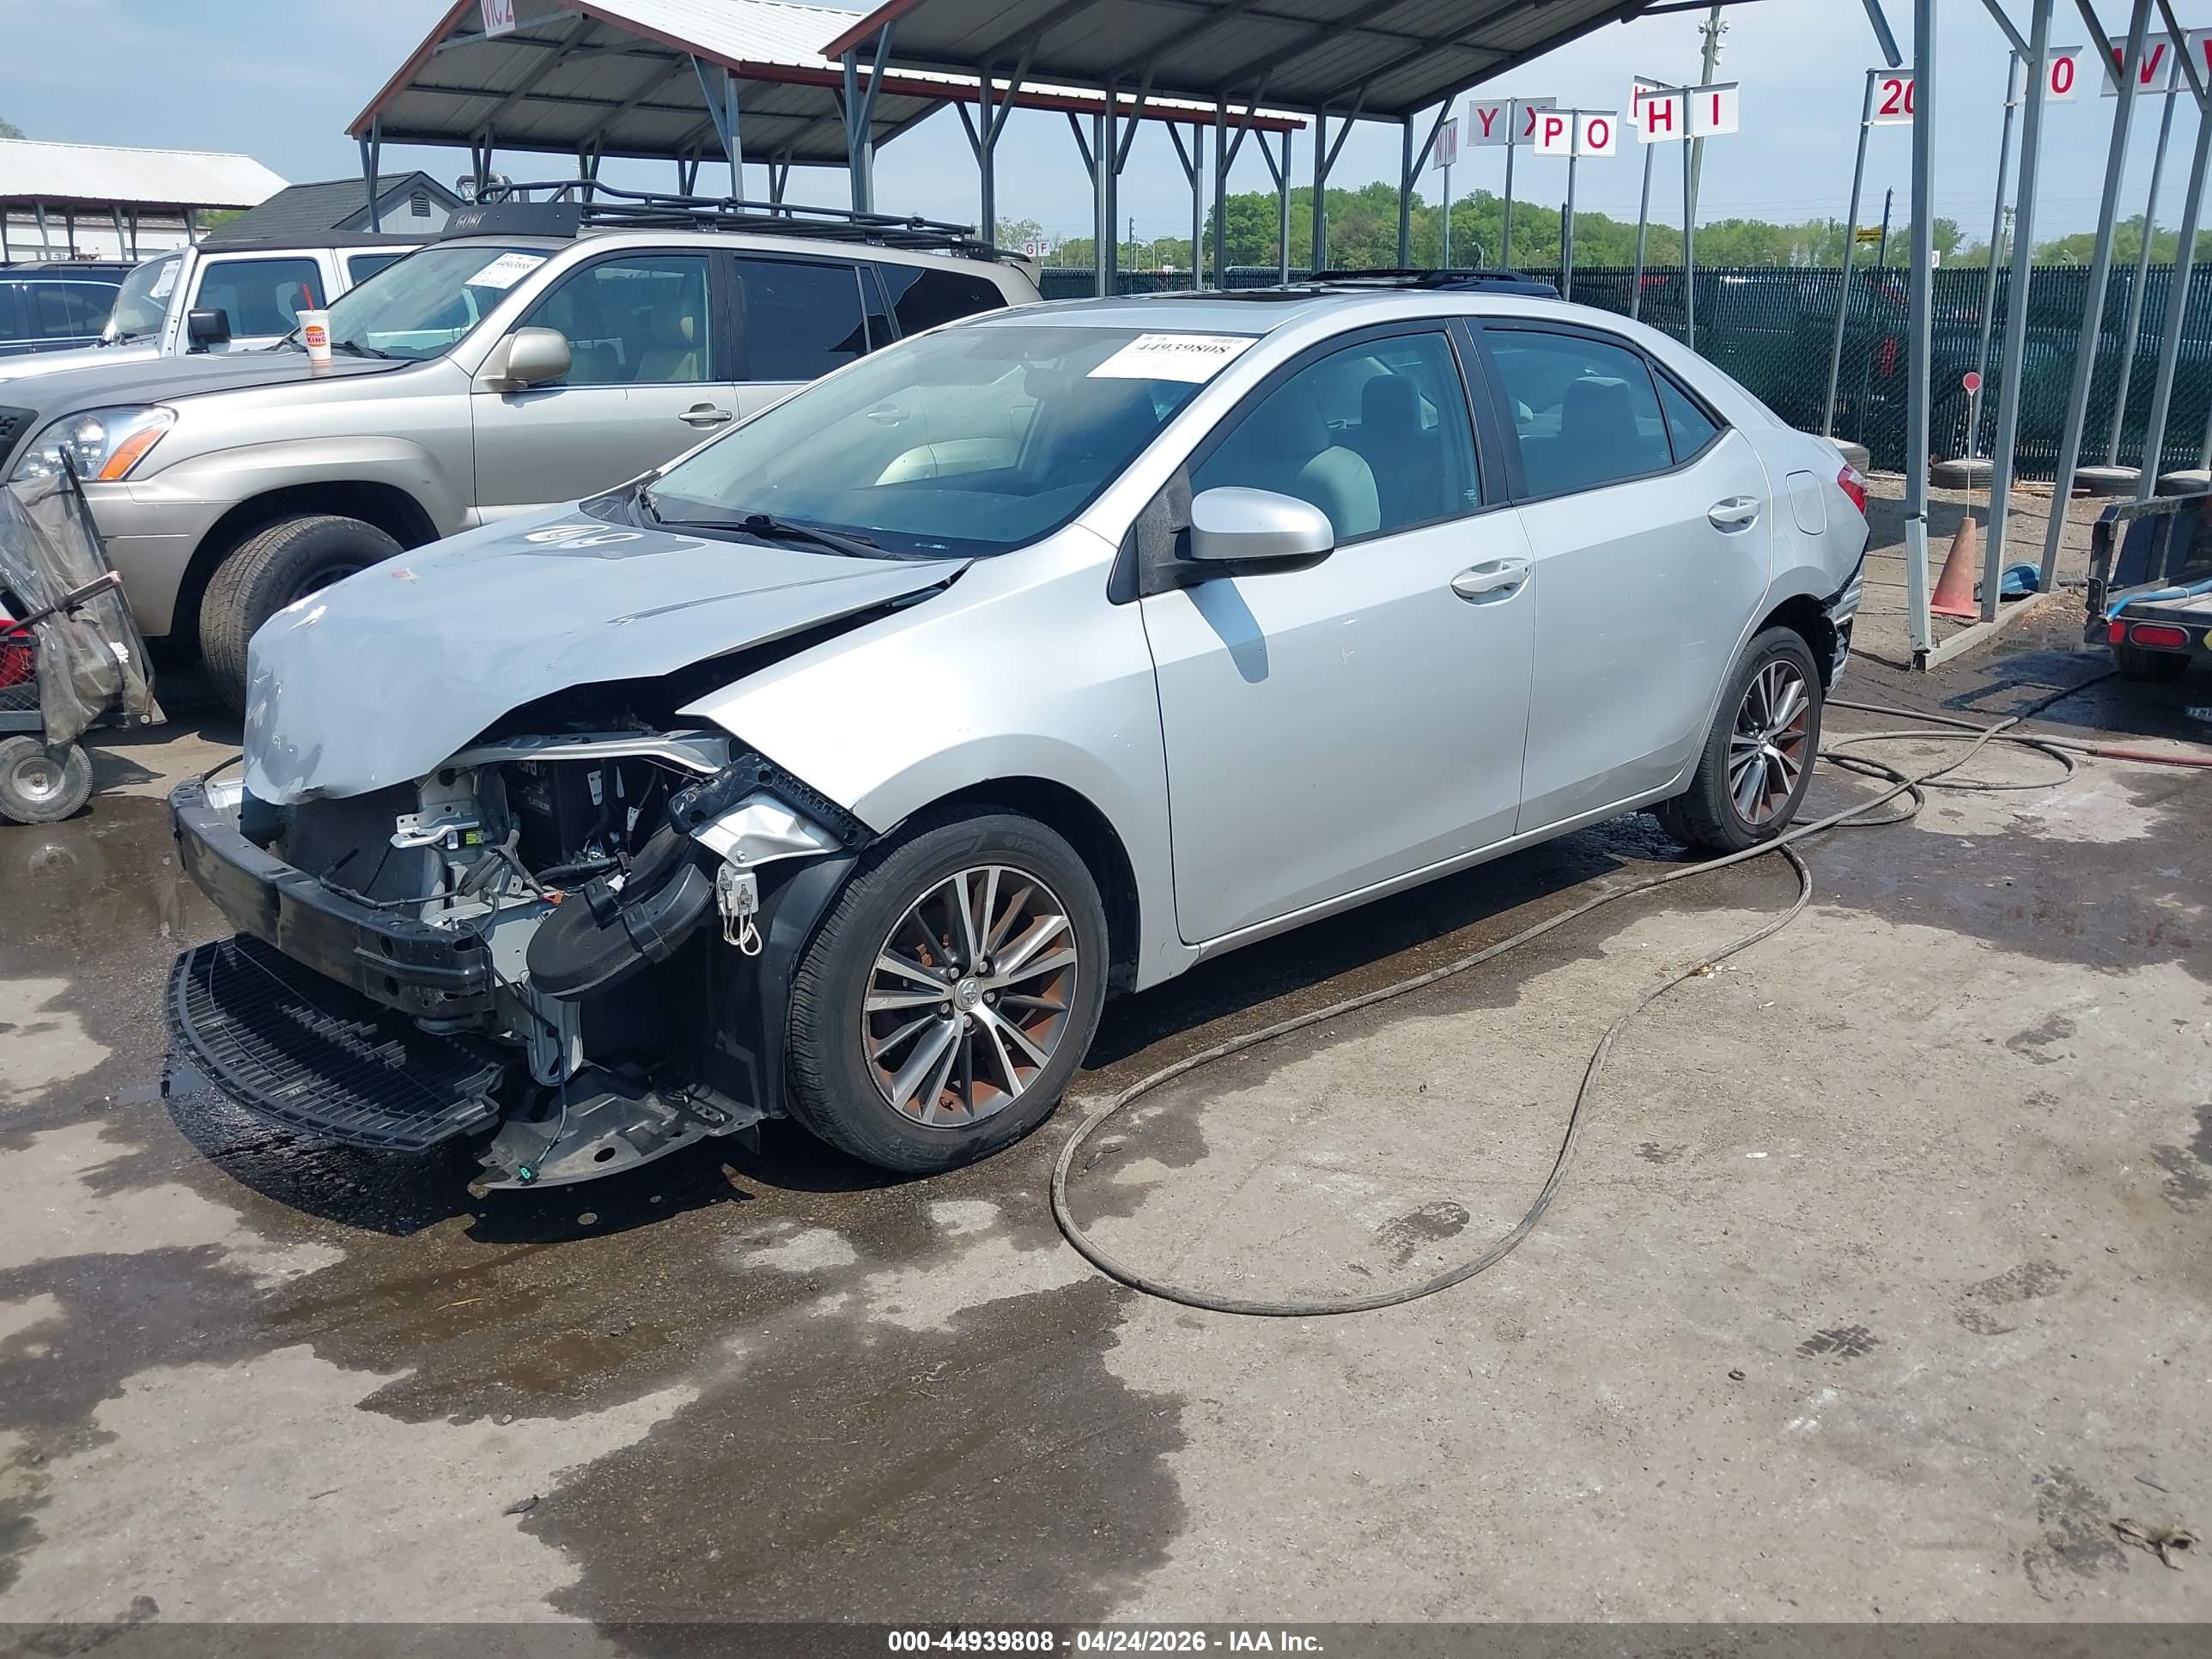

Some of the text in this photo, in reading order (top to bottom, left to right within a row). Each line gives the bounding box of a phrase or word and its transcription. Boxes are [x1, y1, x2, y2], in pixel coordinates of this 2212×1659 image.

[1476, 107, 1499, 137] Y
[1649, 99, 1672, 133] H
[1712, 94, 1719, 126] I
[1544, 117, 1564, 148] P
[1026, 242, 1047, 255] G F
[1136, 343, 1231, 355] 44939808
